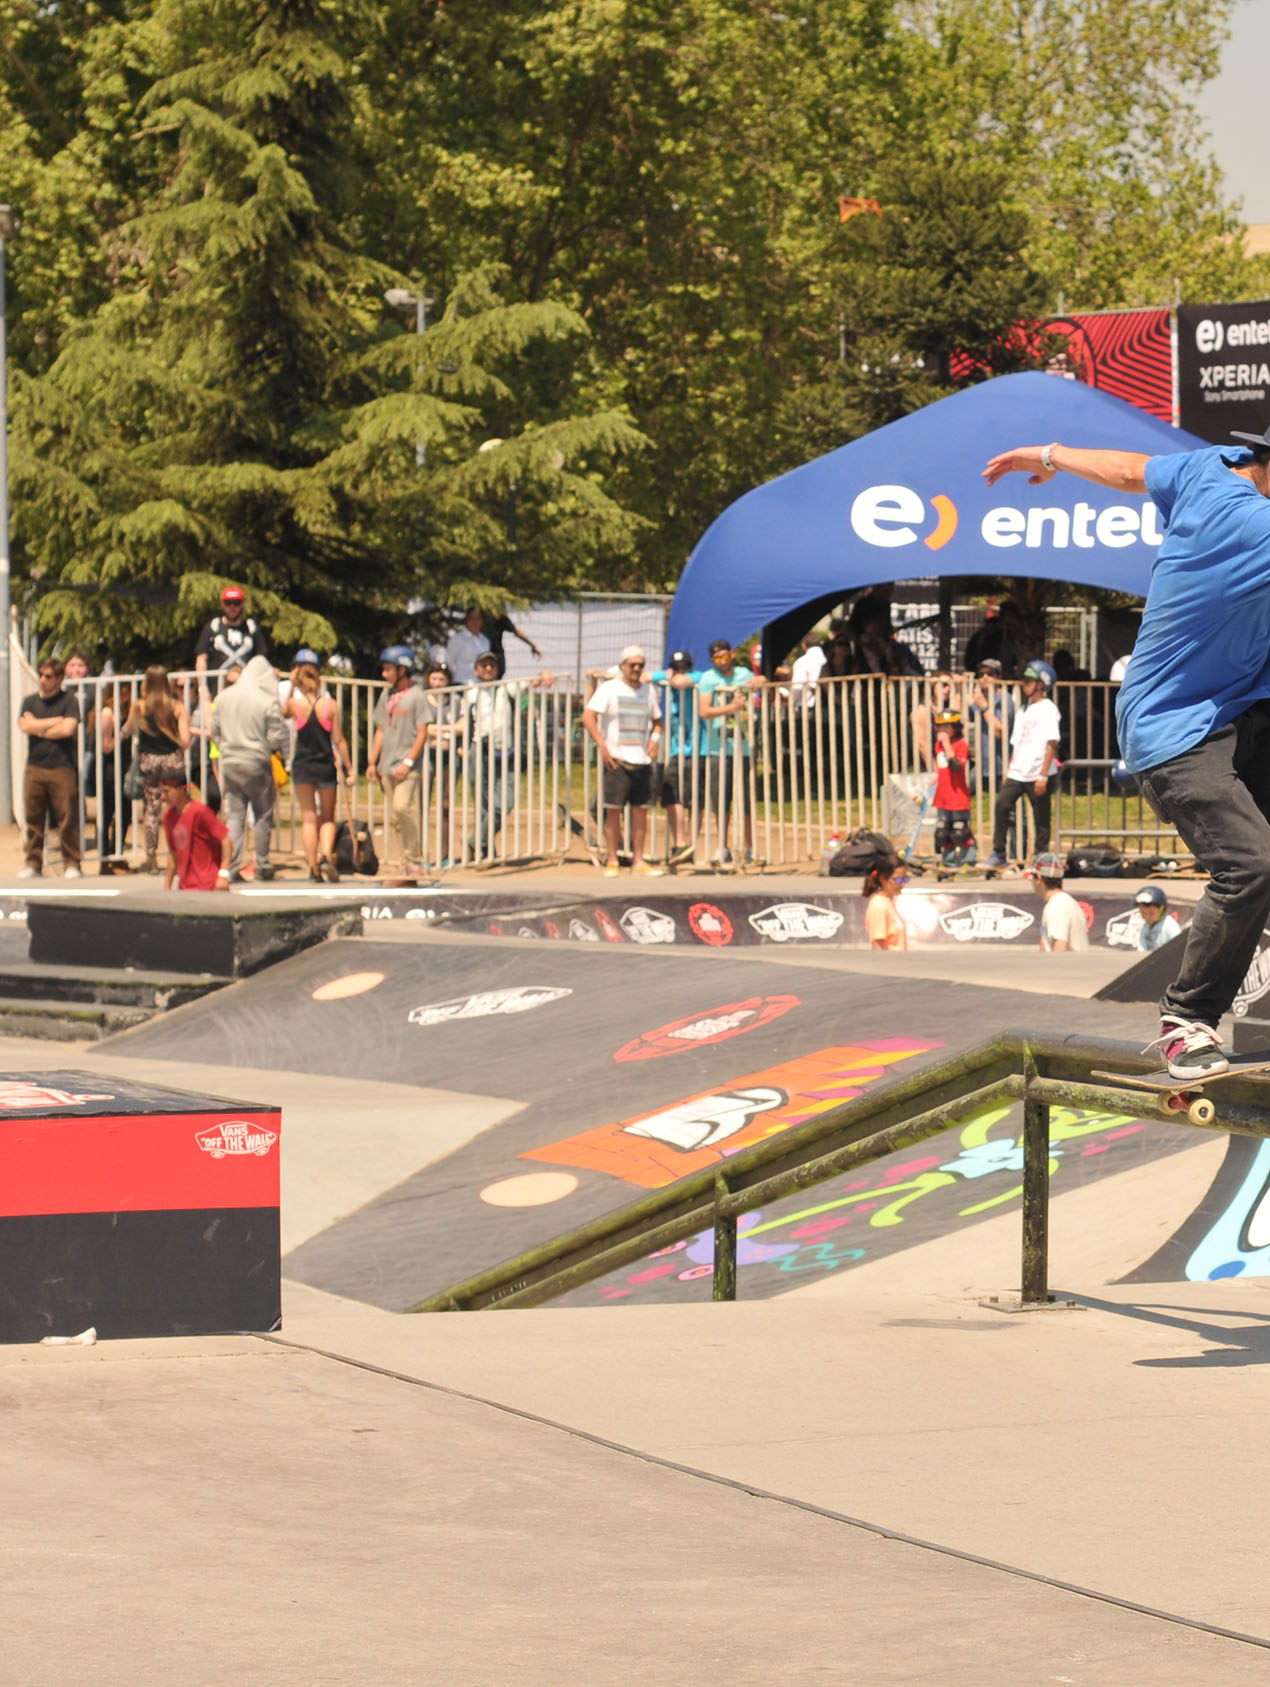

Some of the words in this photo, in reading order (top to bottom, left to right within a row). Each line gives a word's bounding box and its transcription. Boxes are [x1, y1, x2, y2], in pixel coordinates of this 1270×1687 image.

[1199, 363, 1270, 388] XPERIA
[981, 502, 1164, 548] entel
[219, 1124, 249, 1136] VANS
[223, 1136, 244, 1151] THE
